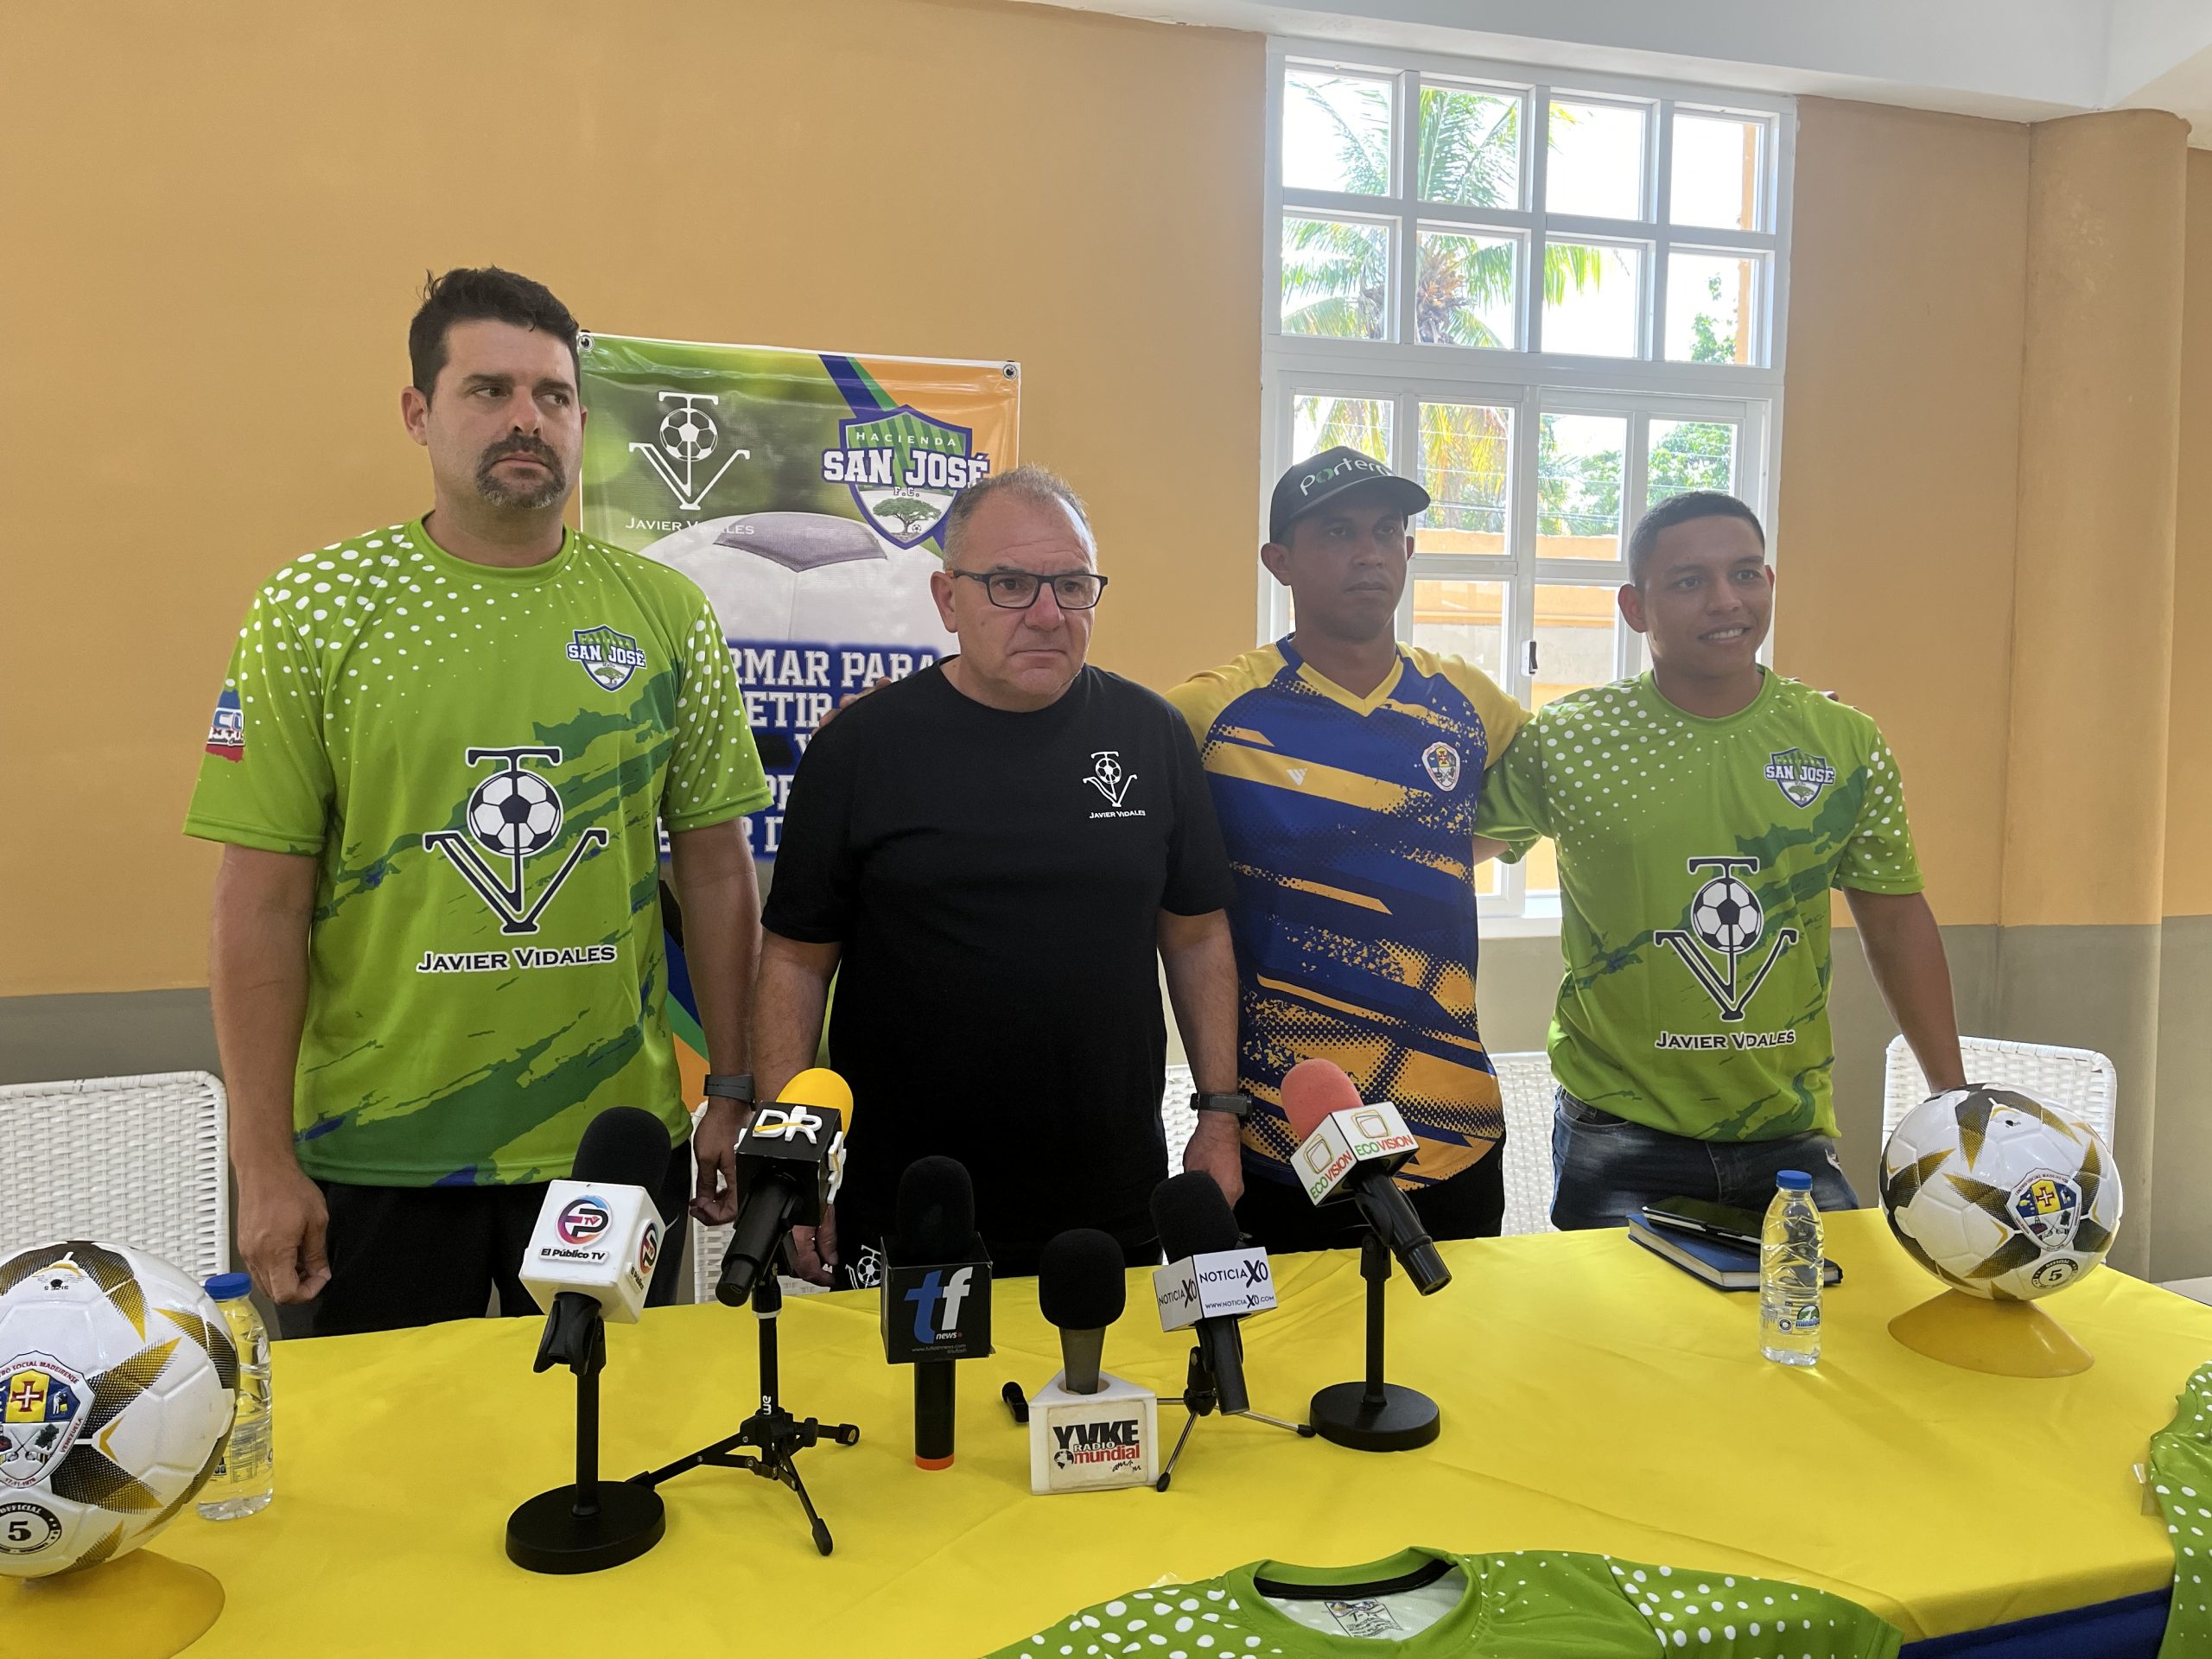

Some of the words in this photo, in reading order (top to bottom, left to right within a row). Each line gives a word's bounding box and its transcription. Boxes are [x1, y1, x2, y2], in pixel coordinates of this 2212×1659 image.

[856, 432, 956, 446] HACIENDA
[823, 448, 893, 484] SAN
[905, 449, 988, 489] JOSÉ
[893, 486, 920, 497] F.C.
[626, 518, 682, 531] JAVIER
[686, 520, 755, 535] VLES
[568, 645, 602, 661] SAN
[1765, 766, 1795, 779] SAN
[417, 952, 508, 971] JAVIER
[514, 946, 616, 967] VIDALES
[1656, 1033, 1726, 1048] JAVIER
[1354, 1134, 1414, 1156] ECOVISION
[1310, 1150, 1353, 1200] ECOVISION
[552, 1248, 589, 1259] Público
[591, 1252, 606, 1261] TV
[2048, 1268, 2063, 1281] 5
[936, 1332, 957, 1340] news
[12, 1361, 38, 1370] SOCIAL
[60, 1418, 84, 1452] VENEZUELA
[1052, 1419, 1140, 1450] YVKE
[1073, 1441, 1116, 1452] RADIO
[1074, 1444, 1141, 1465] mundial
[8, 1521, 32, 1541] 5
